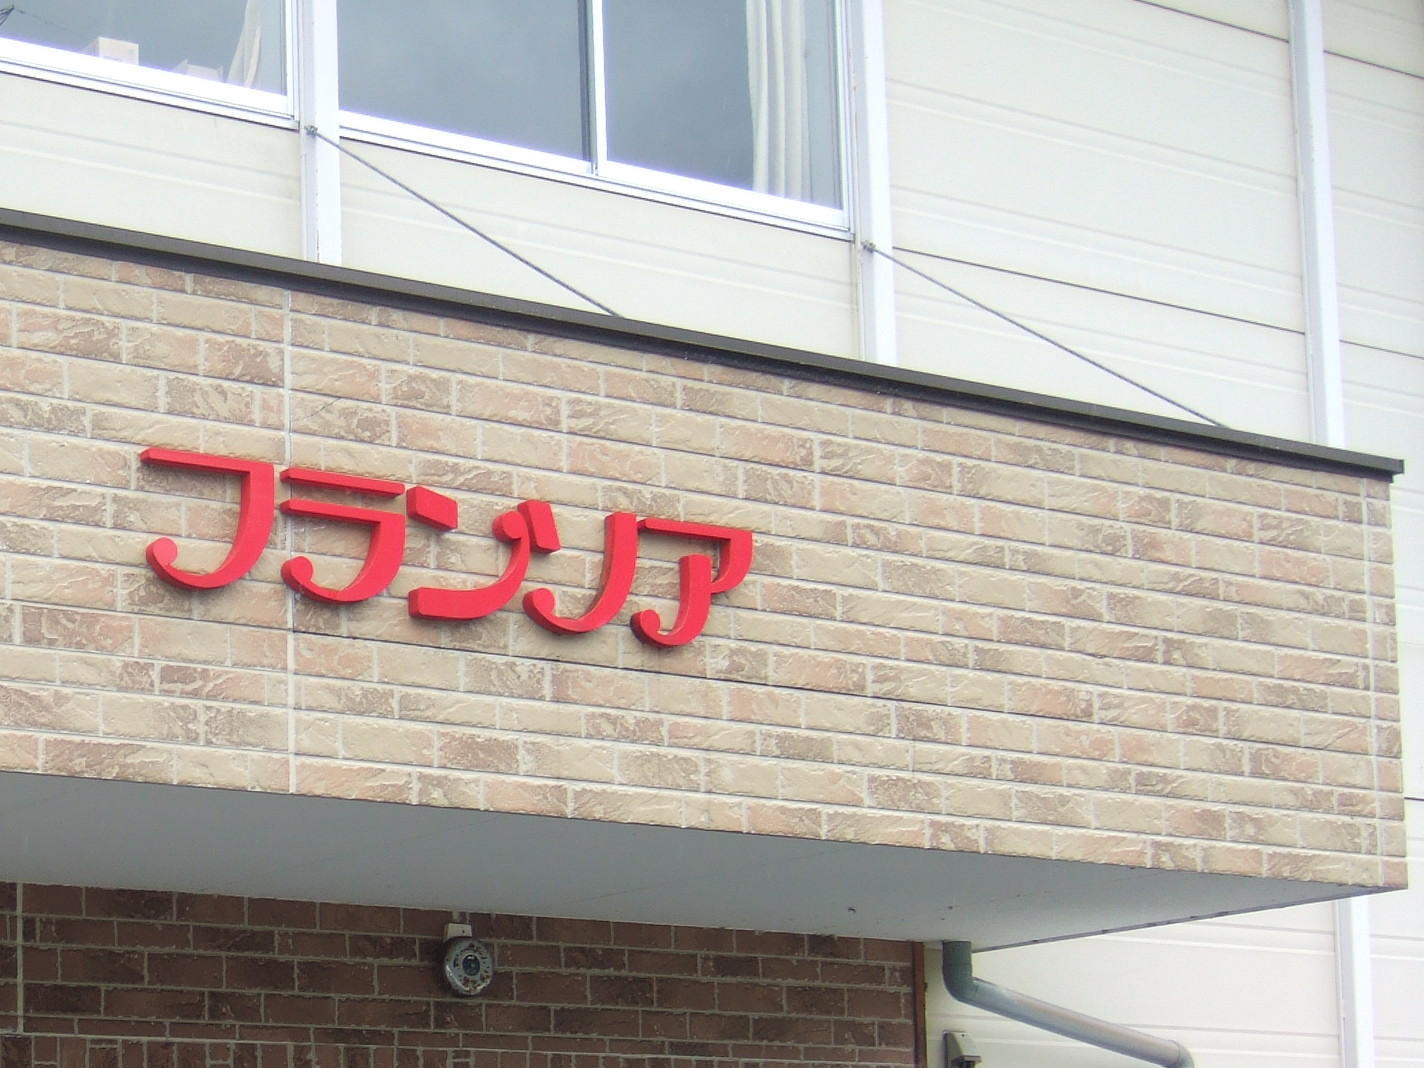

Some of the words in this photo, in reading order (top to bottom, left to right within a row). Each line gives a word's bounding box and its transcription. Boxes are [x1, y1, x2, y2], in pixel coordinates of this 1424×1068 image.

[140, 446, 753, 648] フランソア
